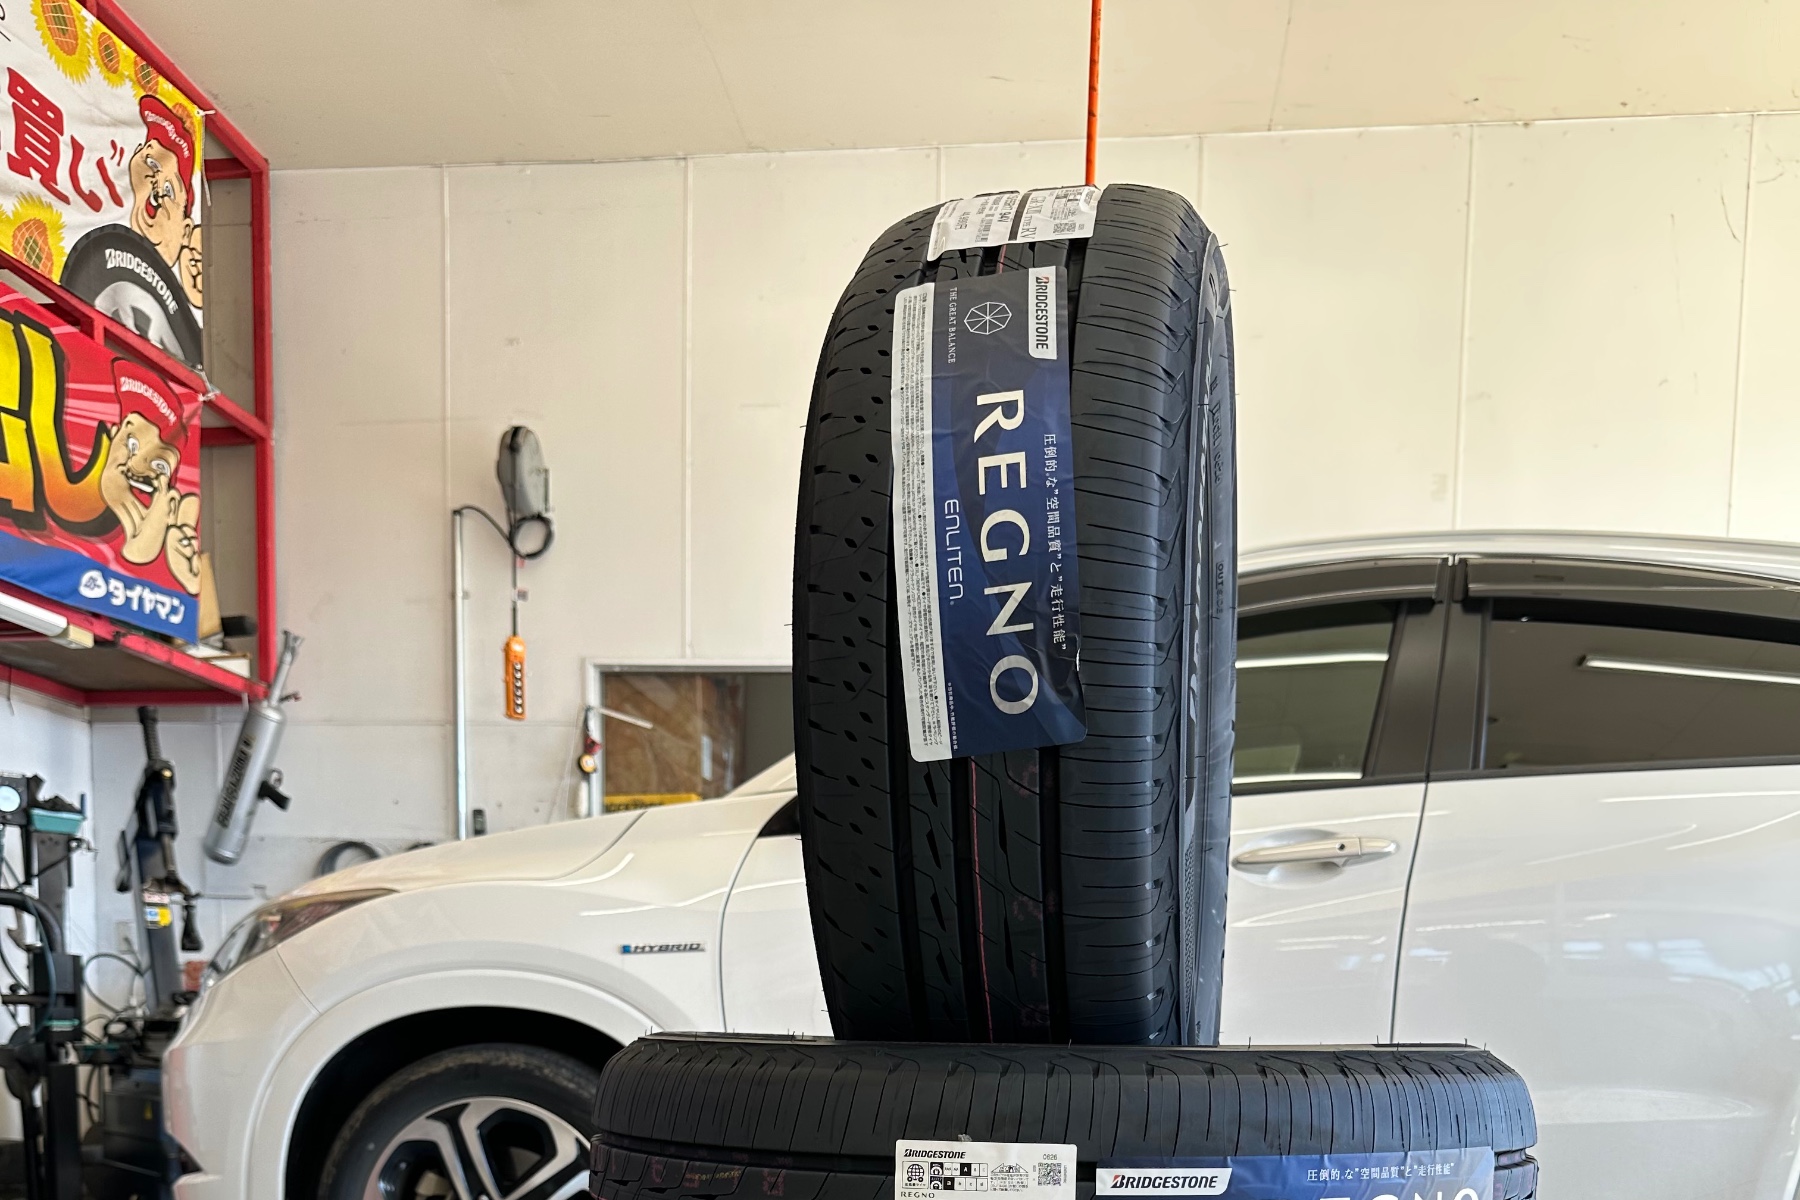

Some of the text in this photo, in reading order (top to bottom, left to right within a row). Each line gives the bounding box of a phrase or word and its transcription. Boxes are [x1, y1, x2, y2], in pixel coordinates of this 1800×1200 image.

[1020, 227, 1037, 239] RV
[105, 248, 179, 315] BRIDGESTONE
[947, 287, 957, 363] THE GREAT BALANCE
[1035, 276, 1050, 350] BRIDGESTONE
[944, 499, 964, 600] ENLITEN
[973, 389, 1039, 715] REGNO
[108, 577, 185, 624] タイヤマン
[632, 943, 702, 953] HYBRID
[903, 1148, 966, 1159] BRIDGESTONE
[900, 1191, 935, 1199] REGNO
[1110, 1174, 1218, 1189] BRIDGESTONE
